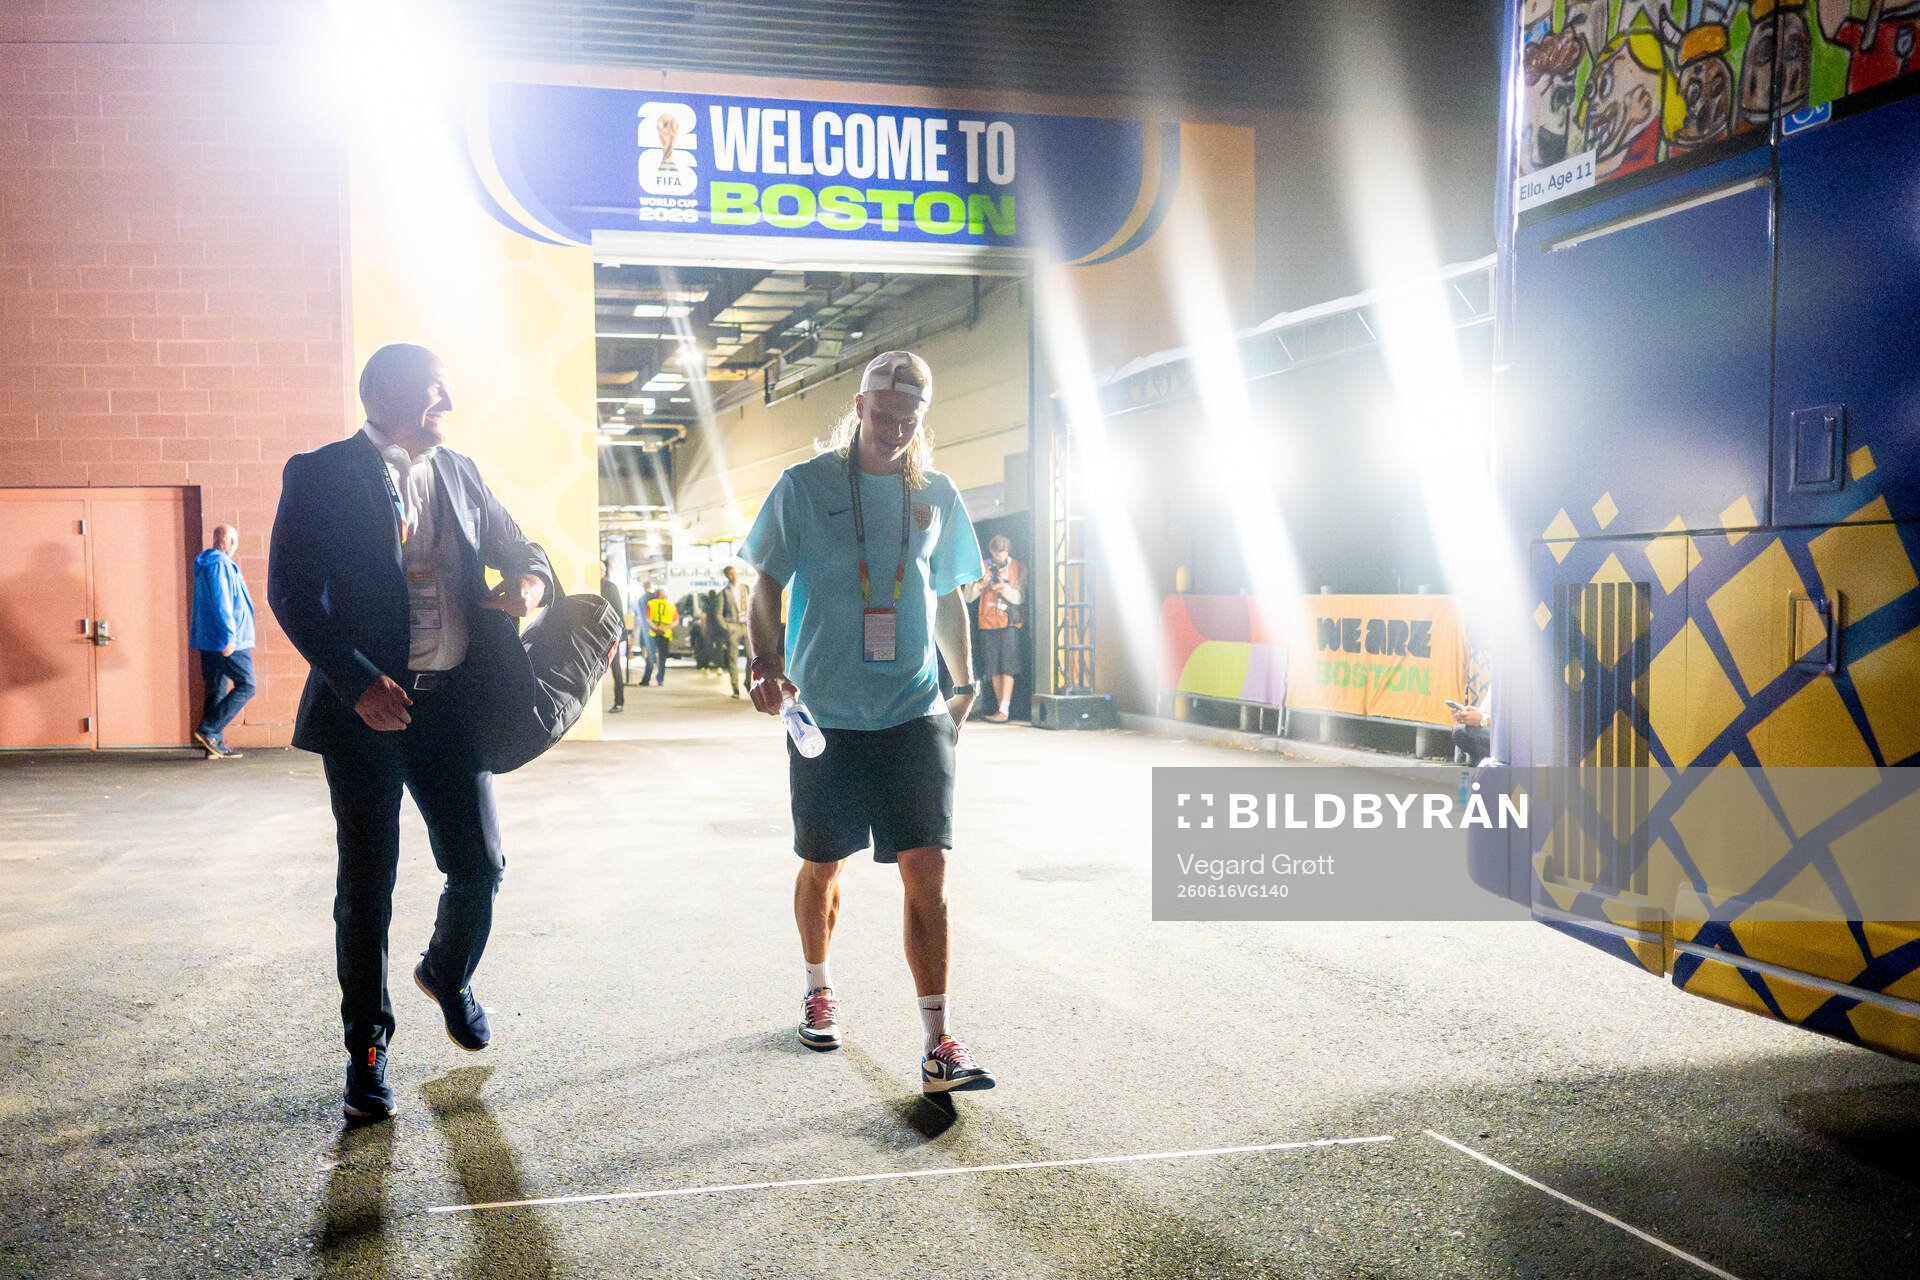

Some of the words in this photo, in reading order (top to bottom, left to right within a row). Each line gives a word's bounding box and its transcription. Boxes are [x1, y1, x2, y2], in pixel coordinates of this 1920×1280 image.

[709, 105, 949, 181] WELCOME
[958, 120, 1015, 185] TO
[656, 176, 682, 186] FIFA
[1520, 182, 1544, 200] Ella,
[1548, 171, 1573, 190] Age
[1576, 161, 1592, 180] 11
[639, 197, 676, 206] WORLD
[676, 199, 698, 208] CUP
[640, 207, 698, 223] 2026
[710, 181, 1015, 235] BOSTON
[1316, 617, 1361, 653] WE
[1365, 619, 1432, 658] ARE
[1316, 660, 1429, 695] BOSTON
